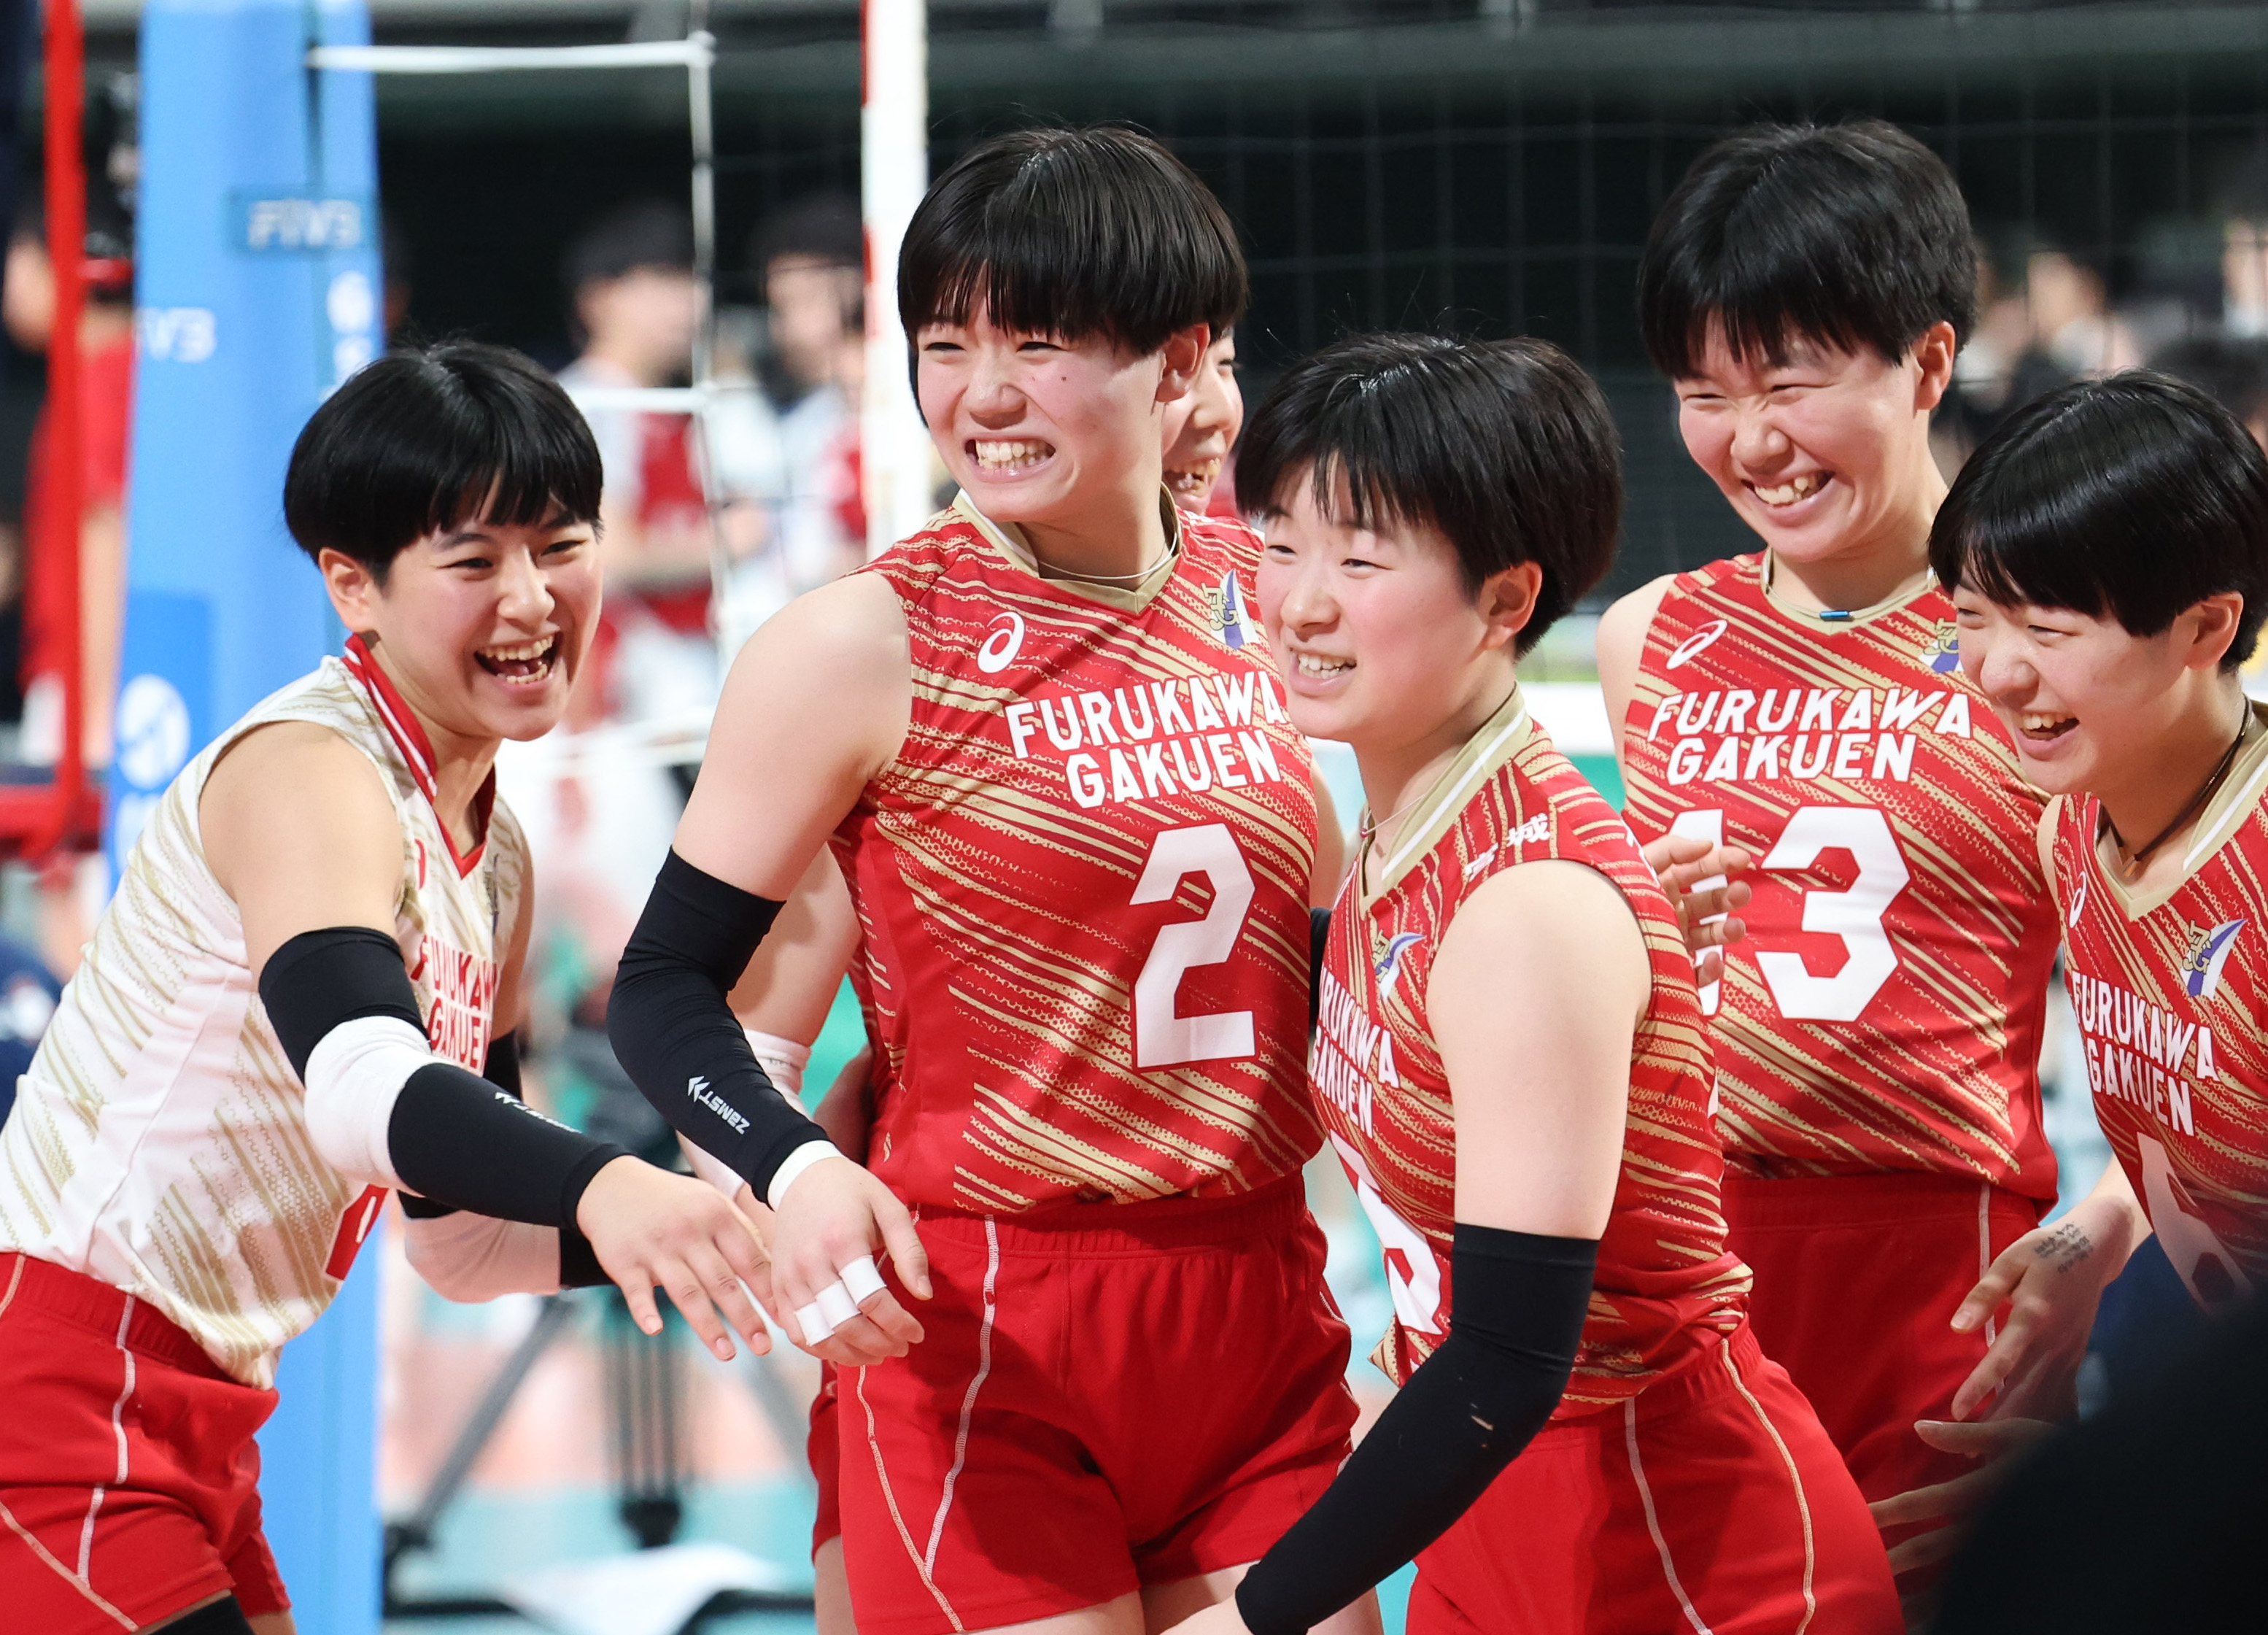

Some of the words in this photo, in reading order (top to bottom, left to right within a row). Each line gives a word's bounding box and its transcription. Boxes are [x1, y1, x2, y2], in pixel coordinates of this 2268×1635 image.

[1005, 670, 1287, 759] FURUKAWA
[1647, 688, 1971, 743] FURUKAWA
[1666, 733, 1918, 786] GAKUEN
[1066, 730, 1281, 808] GAKUEN
[1129, 822, 1256, 1067] 2
[1319, 962, 1401, 1089] RUKAWA
[2071, 970, 2221, 1082] FURUKAWA
[2086, 1037, 2195, 1137] GAKUEN
